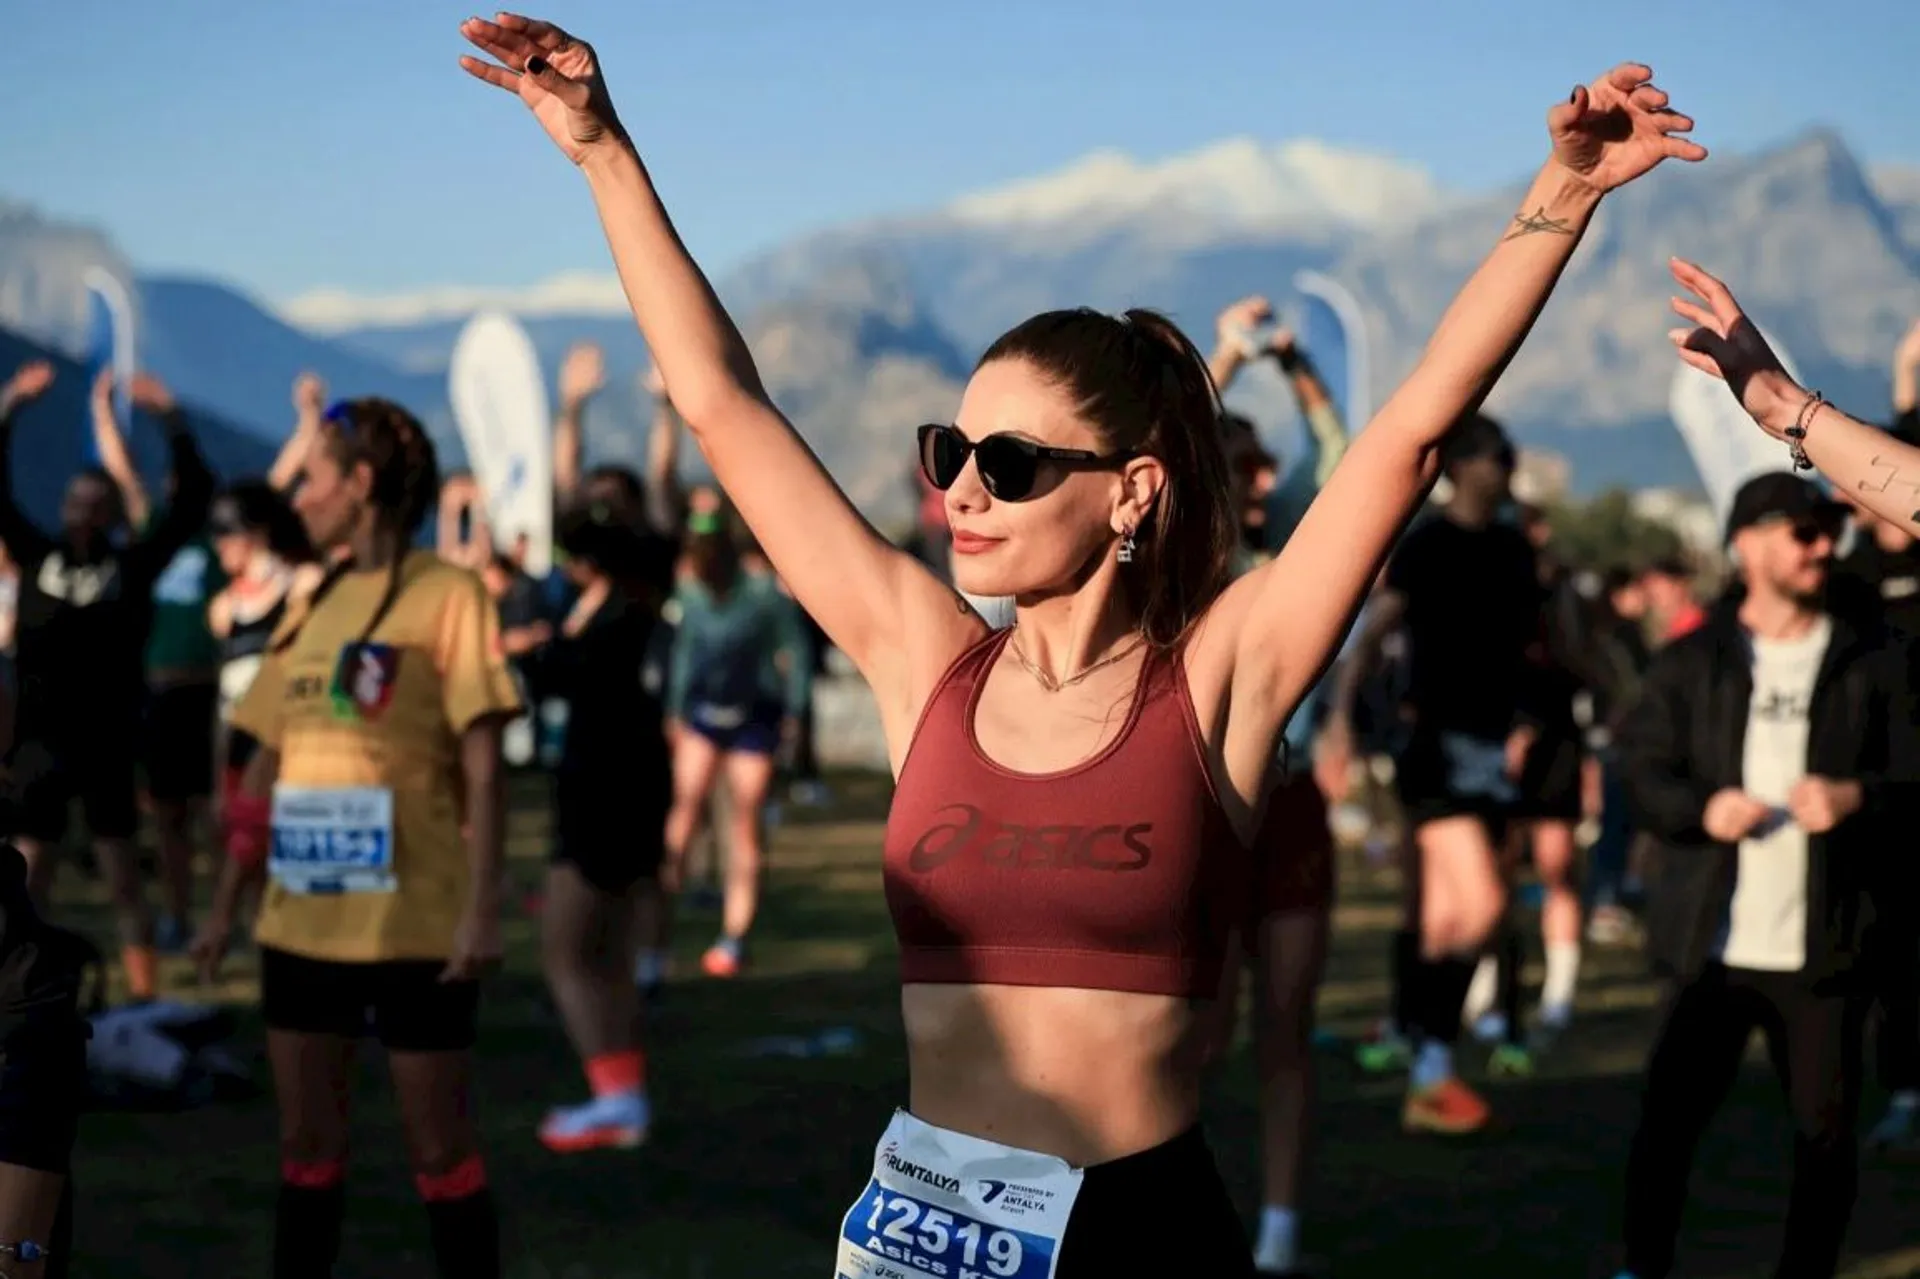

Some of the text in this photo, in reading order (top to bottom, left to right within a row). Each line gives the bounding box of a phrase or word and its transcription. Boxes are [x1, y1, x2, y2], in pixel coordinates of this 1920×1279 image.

[983, 822, 1153, 871] asics
[887, 1154, 960, 1194] RUNTALYA
[1003, 1195, 1045, 1213] ANTALYA
[866, 1190, 1023, 1278] 12519
[866, 1235, 948, 1275] Asics
